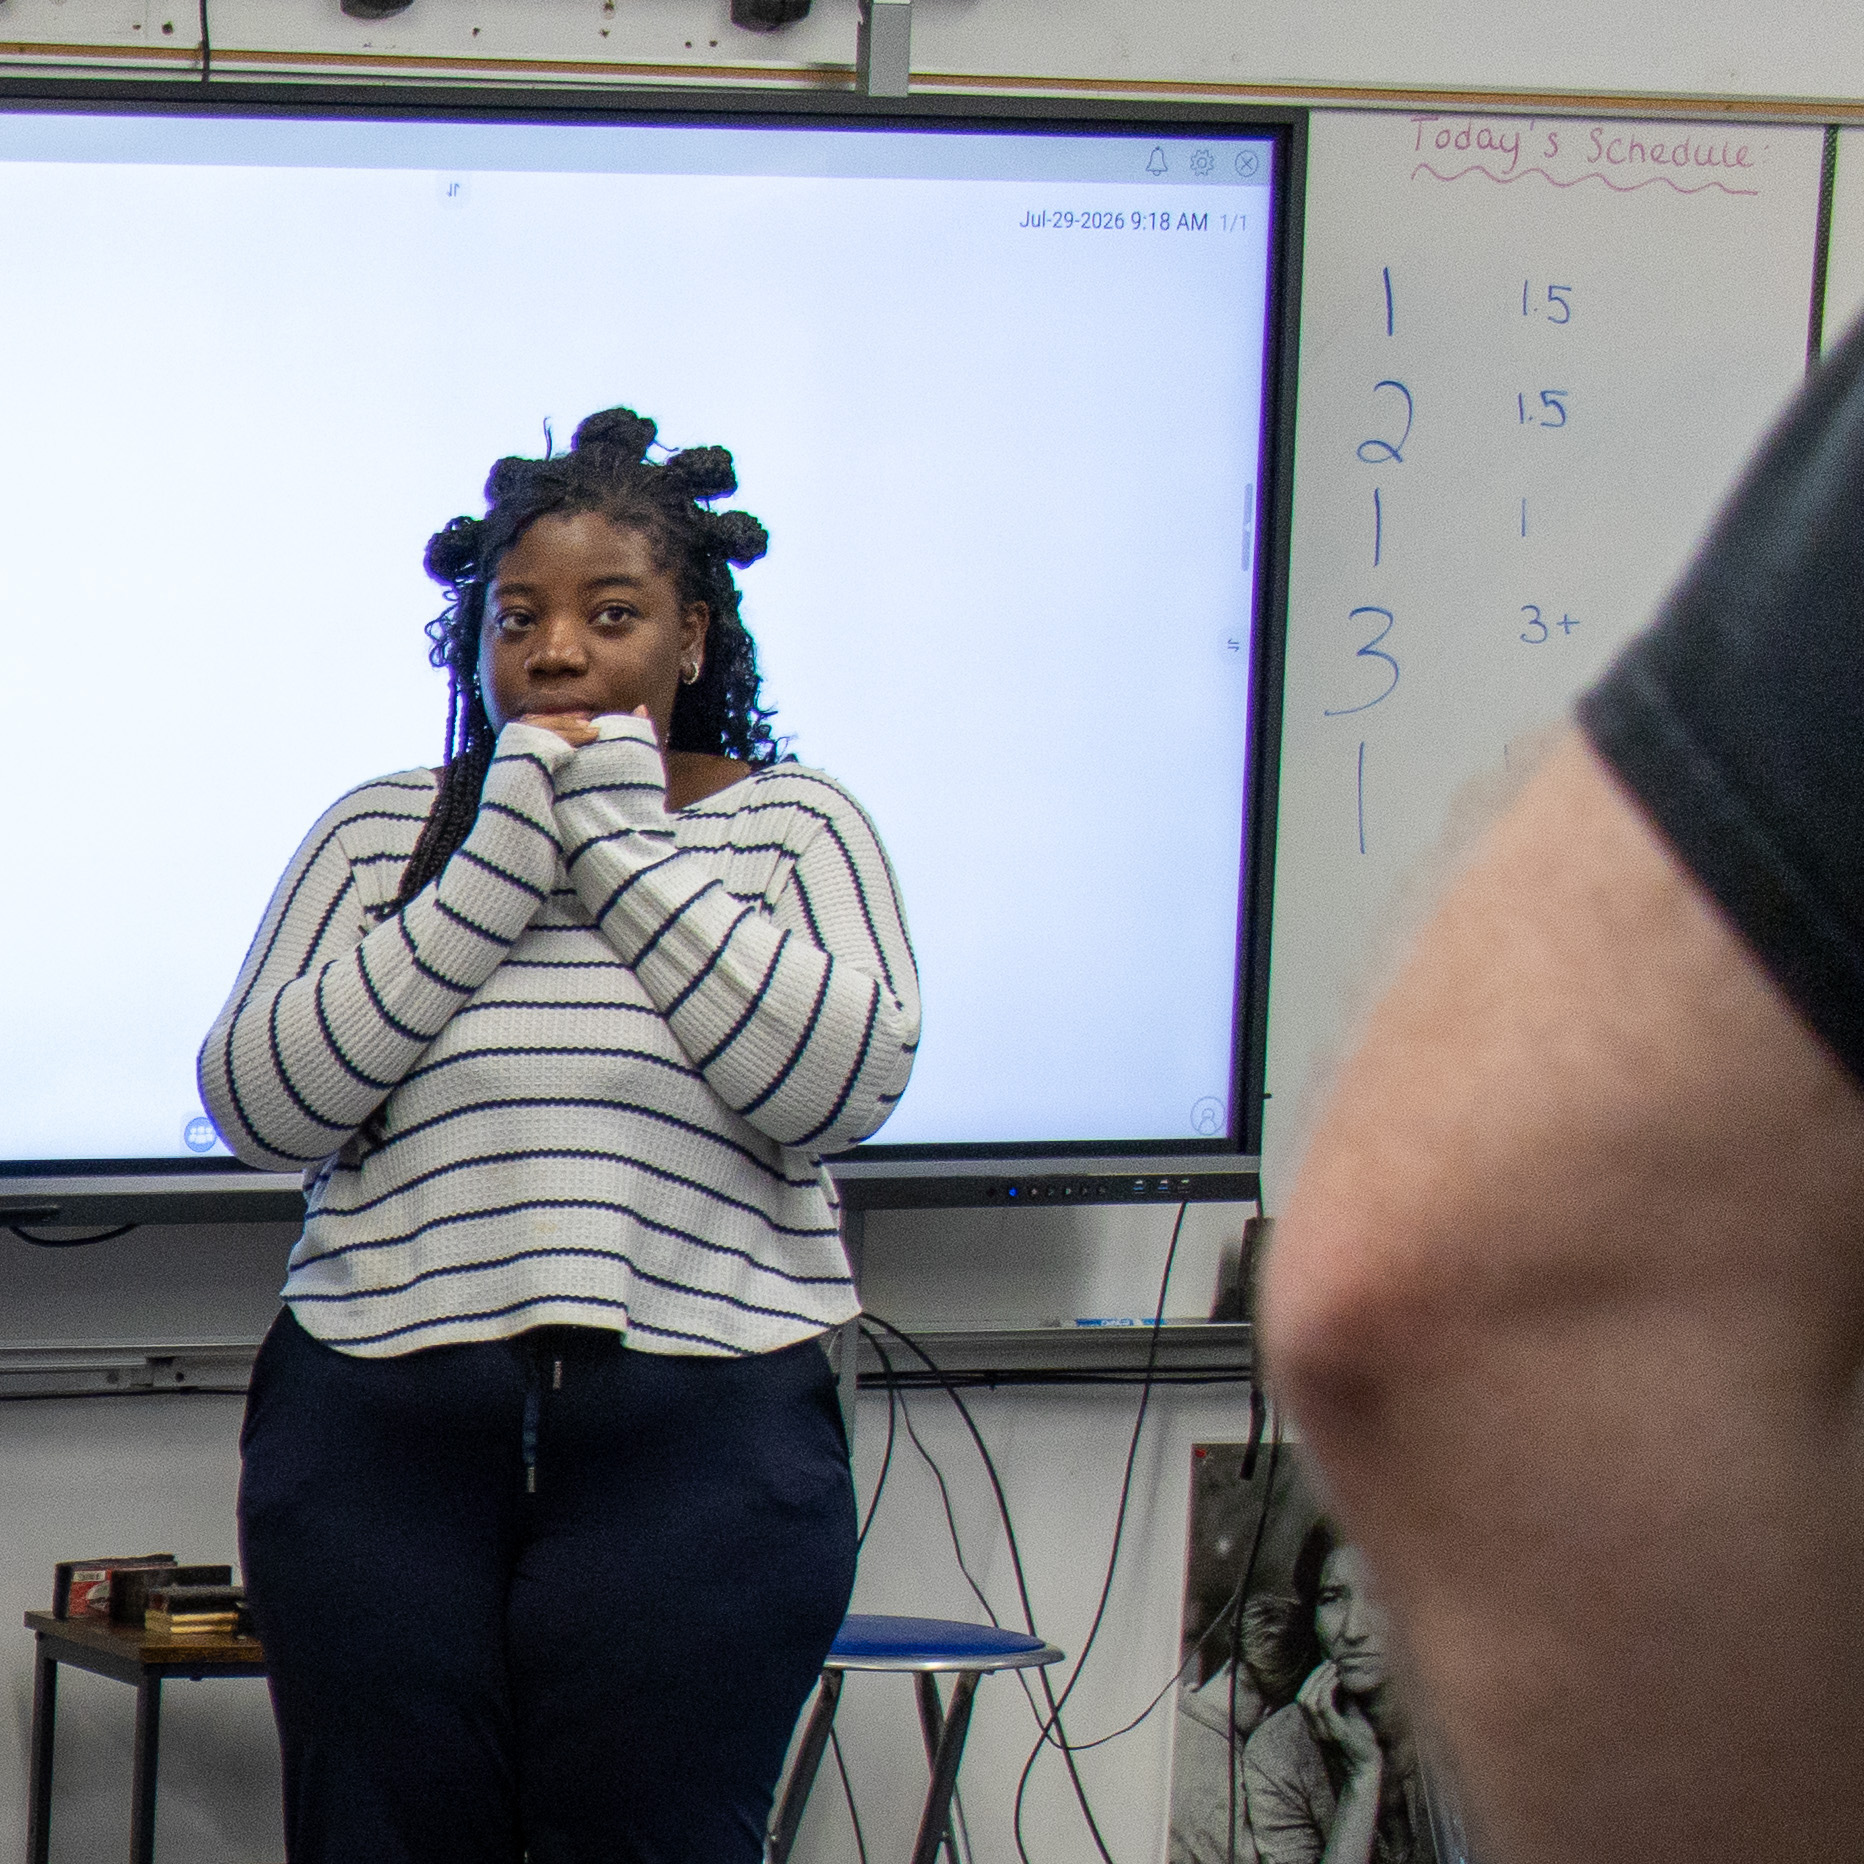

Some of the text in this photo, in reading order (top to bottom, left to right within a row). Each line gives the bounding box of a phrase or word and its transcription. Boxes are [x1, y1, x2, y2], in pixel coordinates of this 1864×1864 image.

[1410, 115, 1559, 174] Today's
[1020, 210, 1248, 232] Jul-29-2026 9:18 AM 1/1
[1522, 280, 1571, 324] 1.5
[1357, 381, 1413, 463] 2
[1325, 605, 1580, 716] 3 3+
